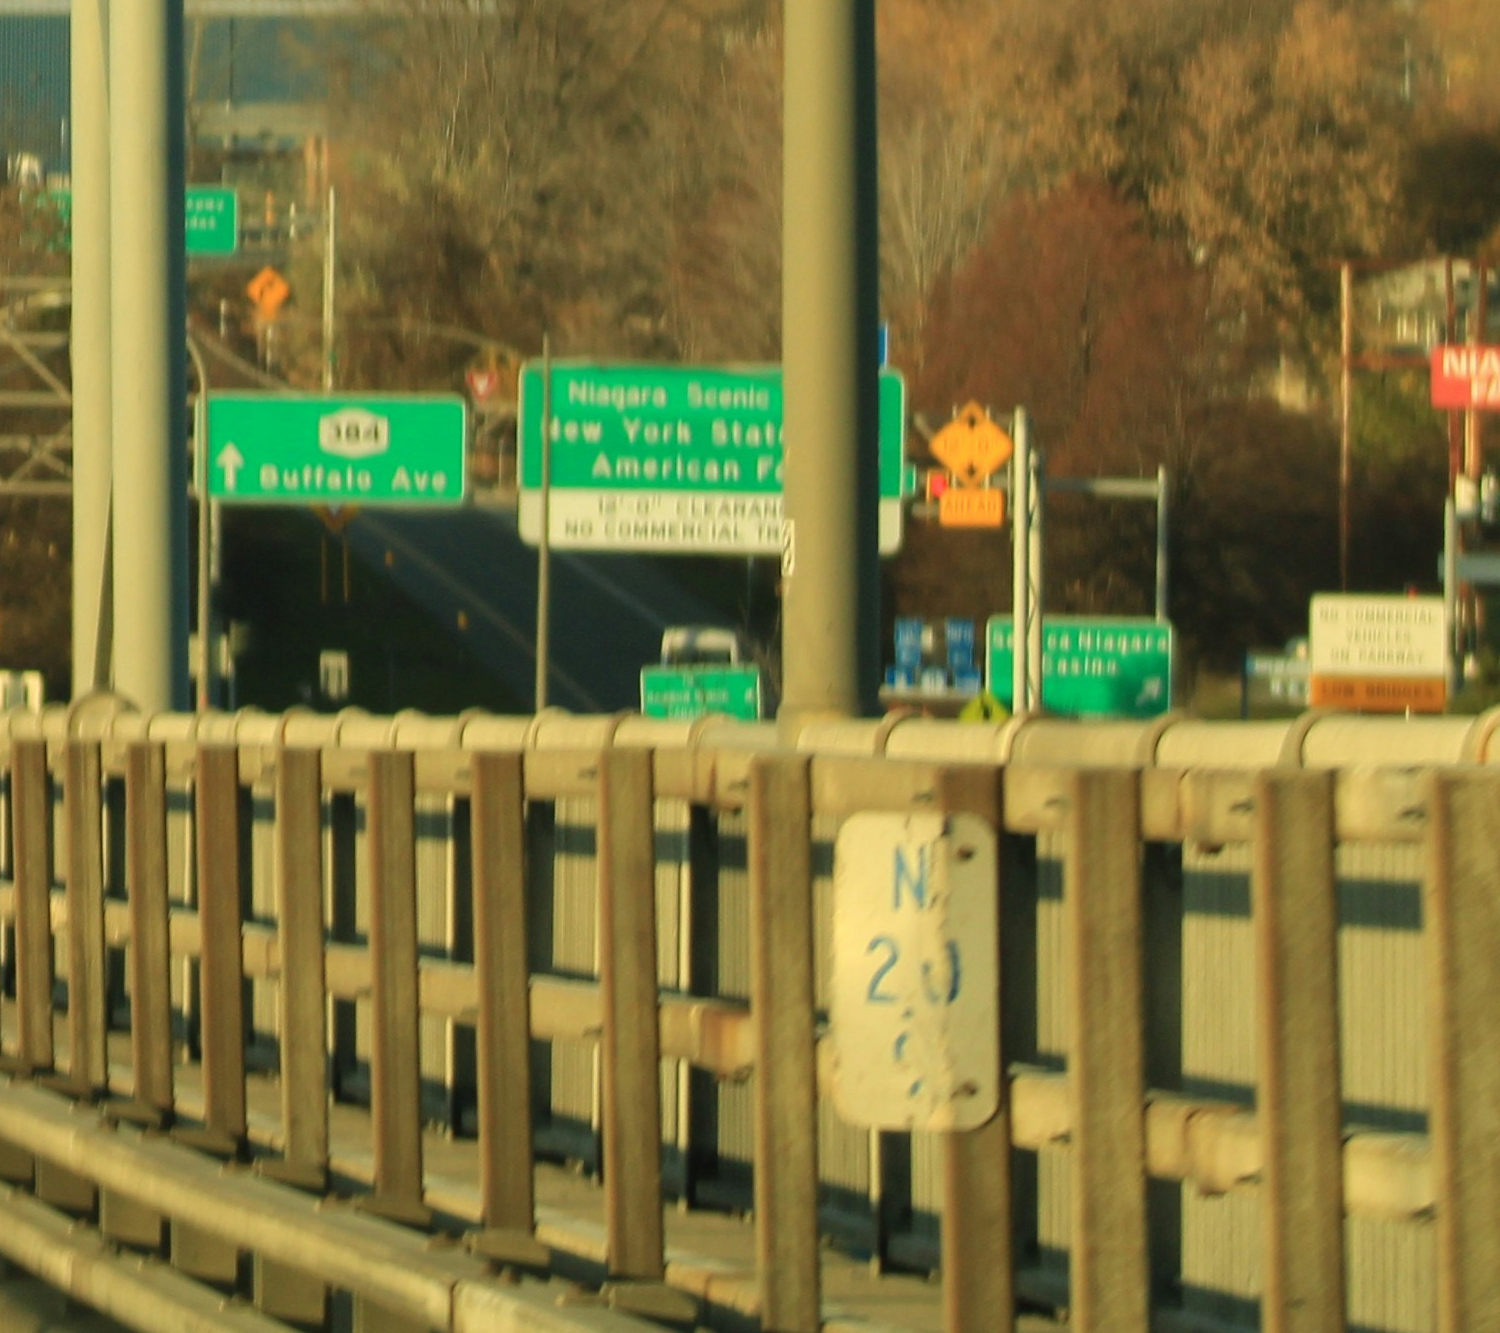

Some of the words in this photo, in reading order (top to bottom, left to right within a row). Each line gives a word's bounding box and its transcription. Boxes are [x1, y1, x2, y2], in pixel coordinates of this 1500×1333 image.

[568, 379, 667, 413] Niagara
[687, 380, 770, 409] Scenic
[623, 416, 692, 444] York
[259, 463, 372, 491] Buffalo
[391, 465, 447, 492] Ave
[591, 452, 740, 483] American
[565, 519, 593, 539] NO
[1078, 629, 1168, 655] Niagara
